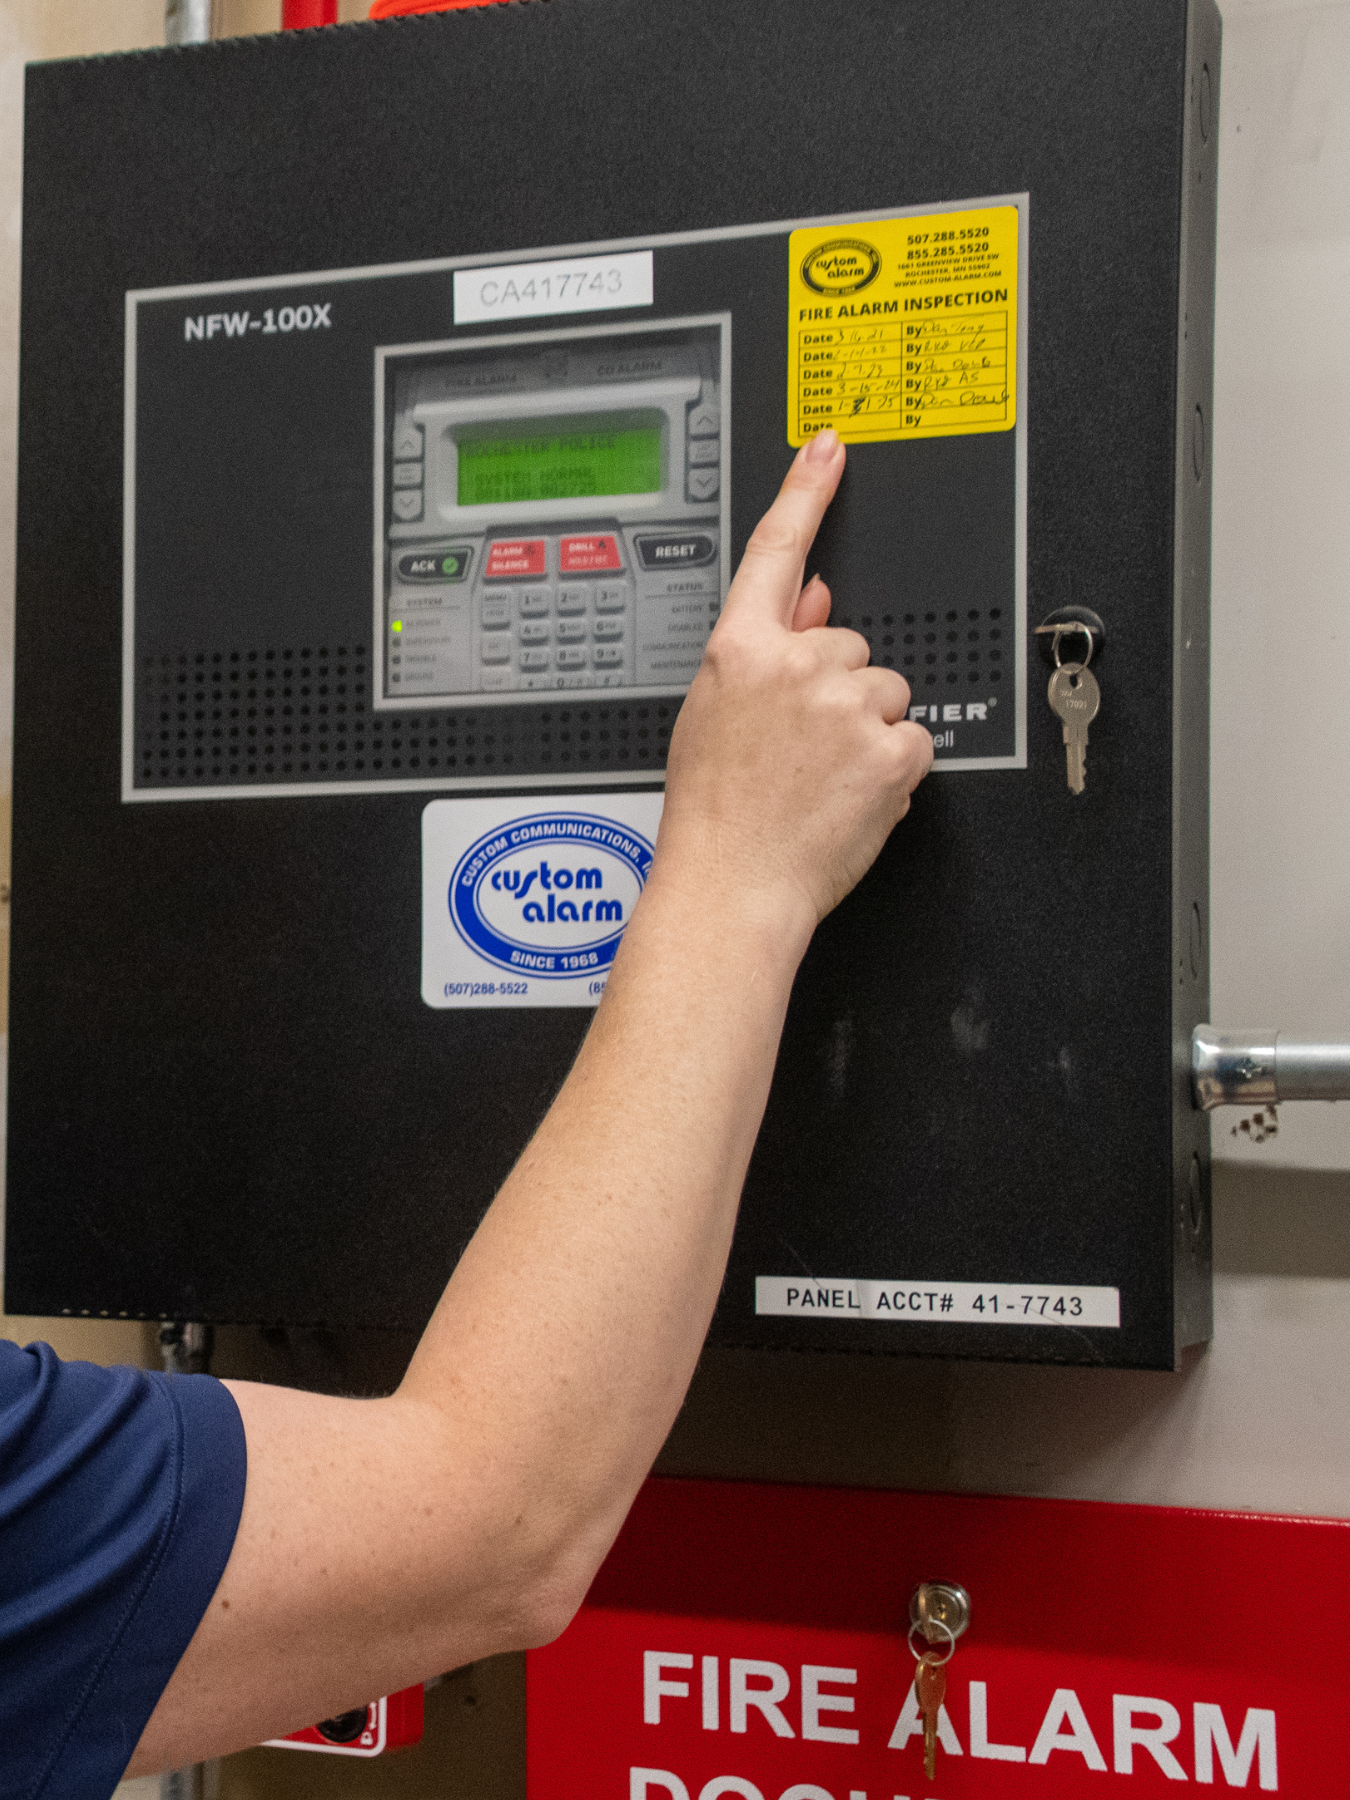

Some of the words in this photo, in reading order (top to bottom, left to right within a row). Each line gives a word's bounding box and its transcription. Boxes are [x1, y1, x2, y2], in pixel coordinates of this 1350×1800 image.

[907, 227, 989, 245] 507.288.5520
[907, 242, 989, 260] 855.285.5520
[815, 256, 858, 271] custom
[916, 258, 961, 268] GREENVIEW
[962, 254, 985, 262] DRIVE
[827, 267, 865, 280] alarm
[953, 265, 966, 273] MN
[479, 268, 623, 307] CA417743
[799, 306, 834, 322] FIRE
[837, 300, 899, 319] ALARM
[903, 289, 1008, 312] INSPECTION
[183, 303, 333, 342] NFW-100X
[803, 334, 833, 344] Date
[906, 326, 922, 338] By
[803, 351, 833, 362] Date
[906, 343, 922, 356] By
[803, 369, 833, 380] Date
[906, 361, 922, 374] By
[803, 387, 833, 398] Date
[906, 379, 922, 392] By
[803, 405, 833, 415] Date
[906, 396, 922, 410] By
[906, 414, 922, 427] By
[492, 547, 523, 557] ALARM
[568, 542, 594, 553] DRILL
[654, 544, 696, 558] RESET
[410, 560, 436, 573] ACK
[492, 559, 529, 571] SILENCE
[667, 583, 703, 592] STATUS
[908, 702, 988, 723] FIER
[933, 730, 954, 748] ell
[462, 839, 508, 887] CUSTOM
[510, 823, 641, 863] COMMUNICATIONS,
[491, 861, 603, 899] custom
[522, 893, 623, 923] alarm
[510, 950, 555, 969] SINCE
[561, 952, 599, 970] 1968
[443, 982, 529, 998] (507)288-5522
[786, 1287, 861, 1310] PANEL
[876, 1291, 955, 1313] ACCT#
[972, 1294, 1084, 1317] 41-7743
[642, 1649, 860, 1745] FIRE
[887, 1672, 1279, 1791] ALARM
